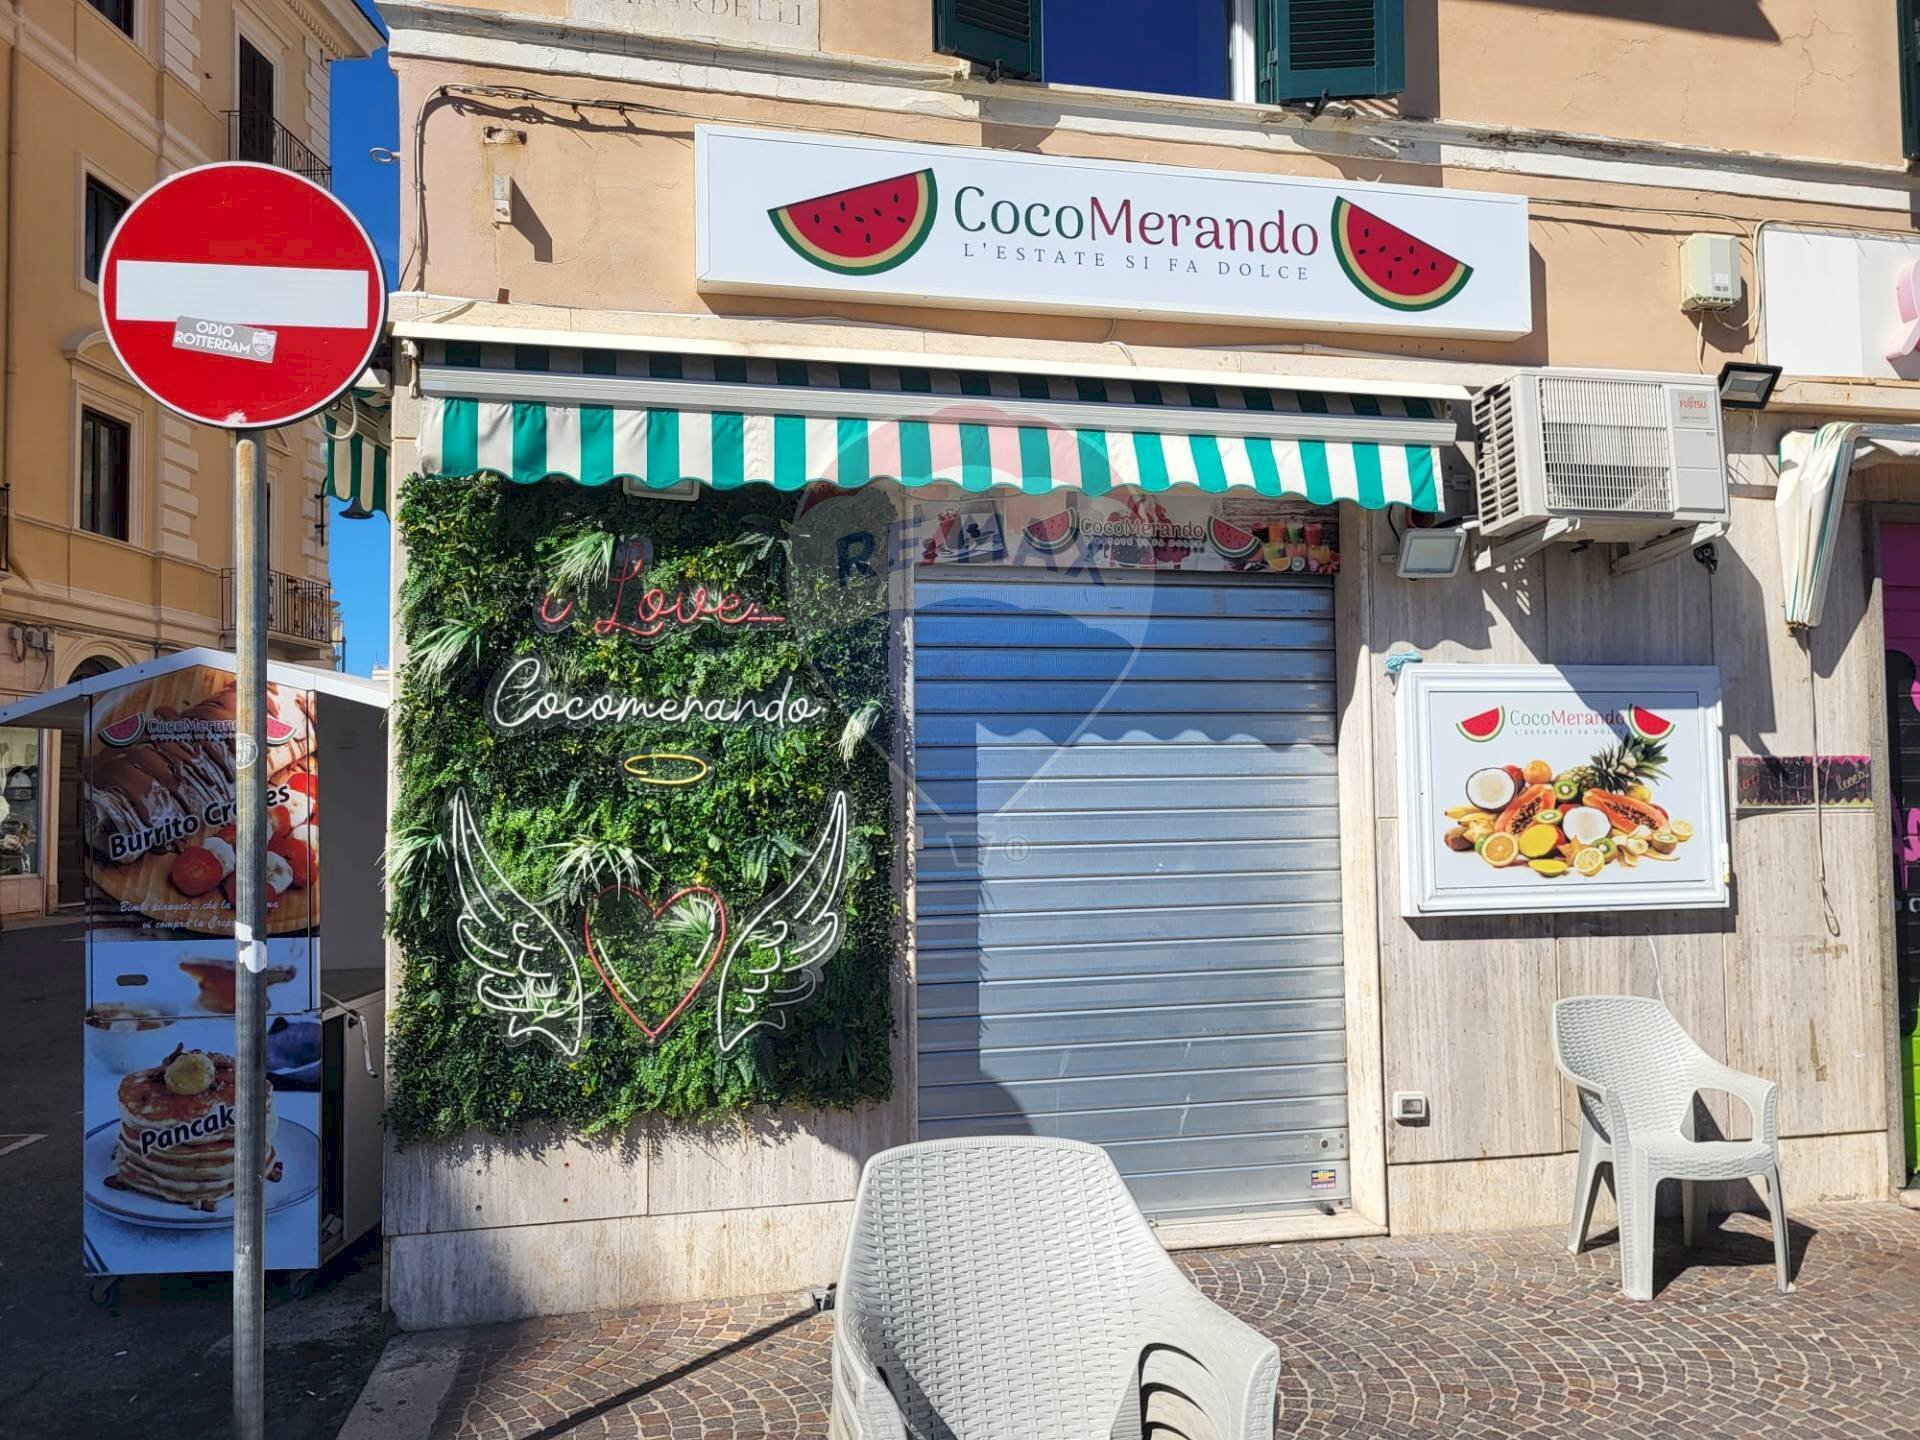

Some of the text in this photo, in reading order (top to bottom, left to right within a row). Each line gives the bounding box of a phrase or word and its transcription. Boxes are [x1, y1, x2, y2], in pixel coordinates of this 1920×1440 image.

[954, 186, 1319, 256] CocoMerando
[964, 243, 1307, 280] L'ESTATE SI FA DOLCE
[196, 321, 235, 338] ODIO
[175, 331, 251, 354] ROTTERDAM
[1679, 399, 1706, 410] FUJITSU
[1081, 517, 1205, 538] CocoMerando
[494, 658, 823, 728] Cocomerando
[148, 718, 237, 734] CocoMeran
[1510, 709, 1625, 726] CocoMerando
[110, 785, 290, 858] Burrito Cres
[141, 1105, 235, 1154] Pancak
